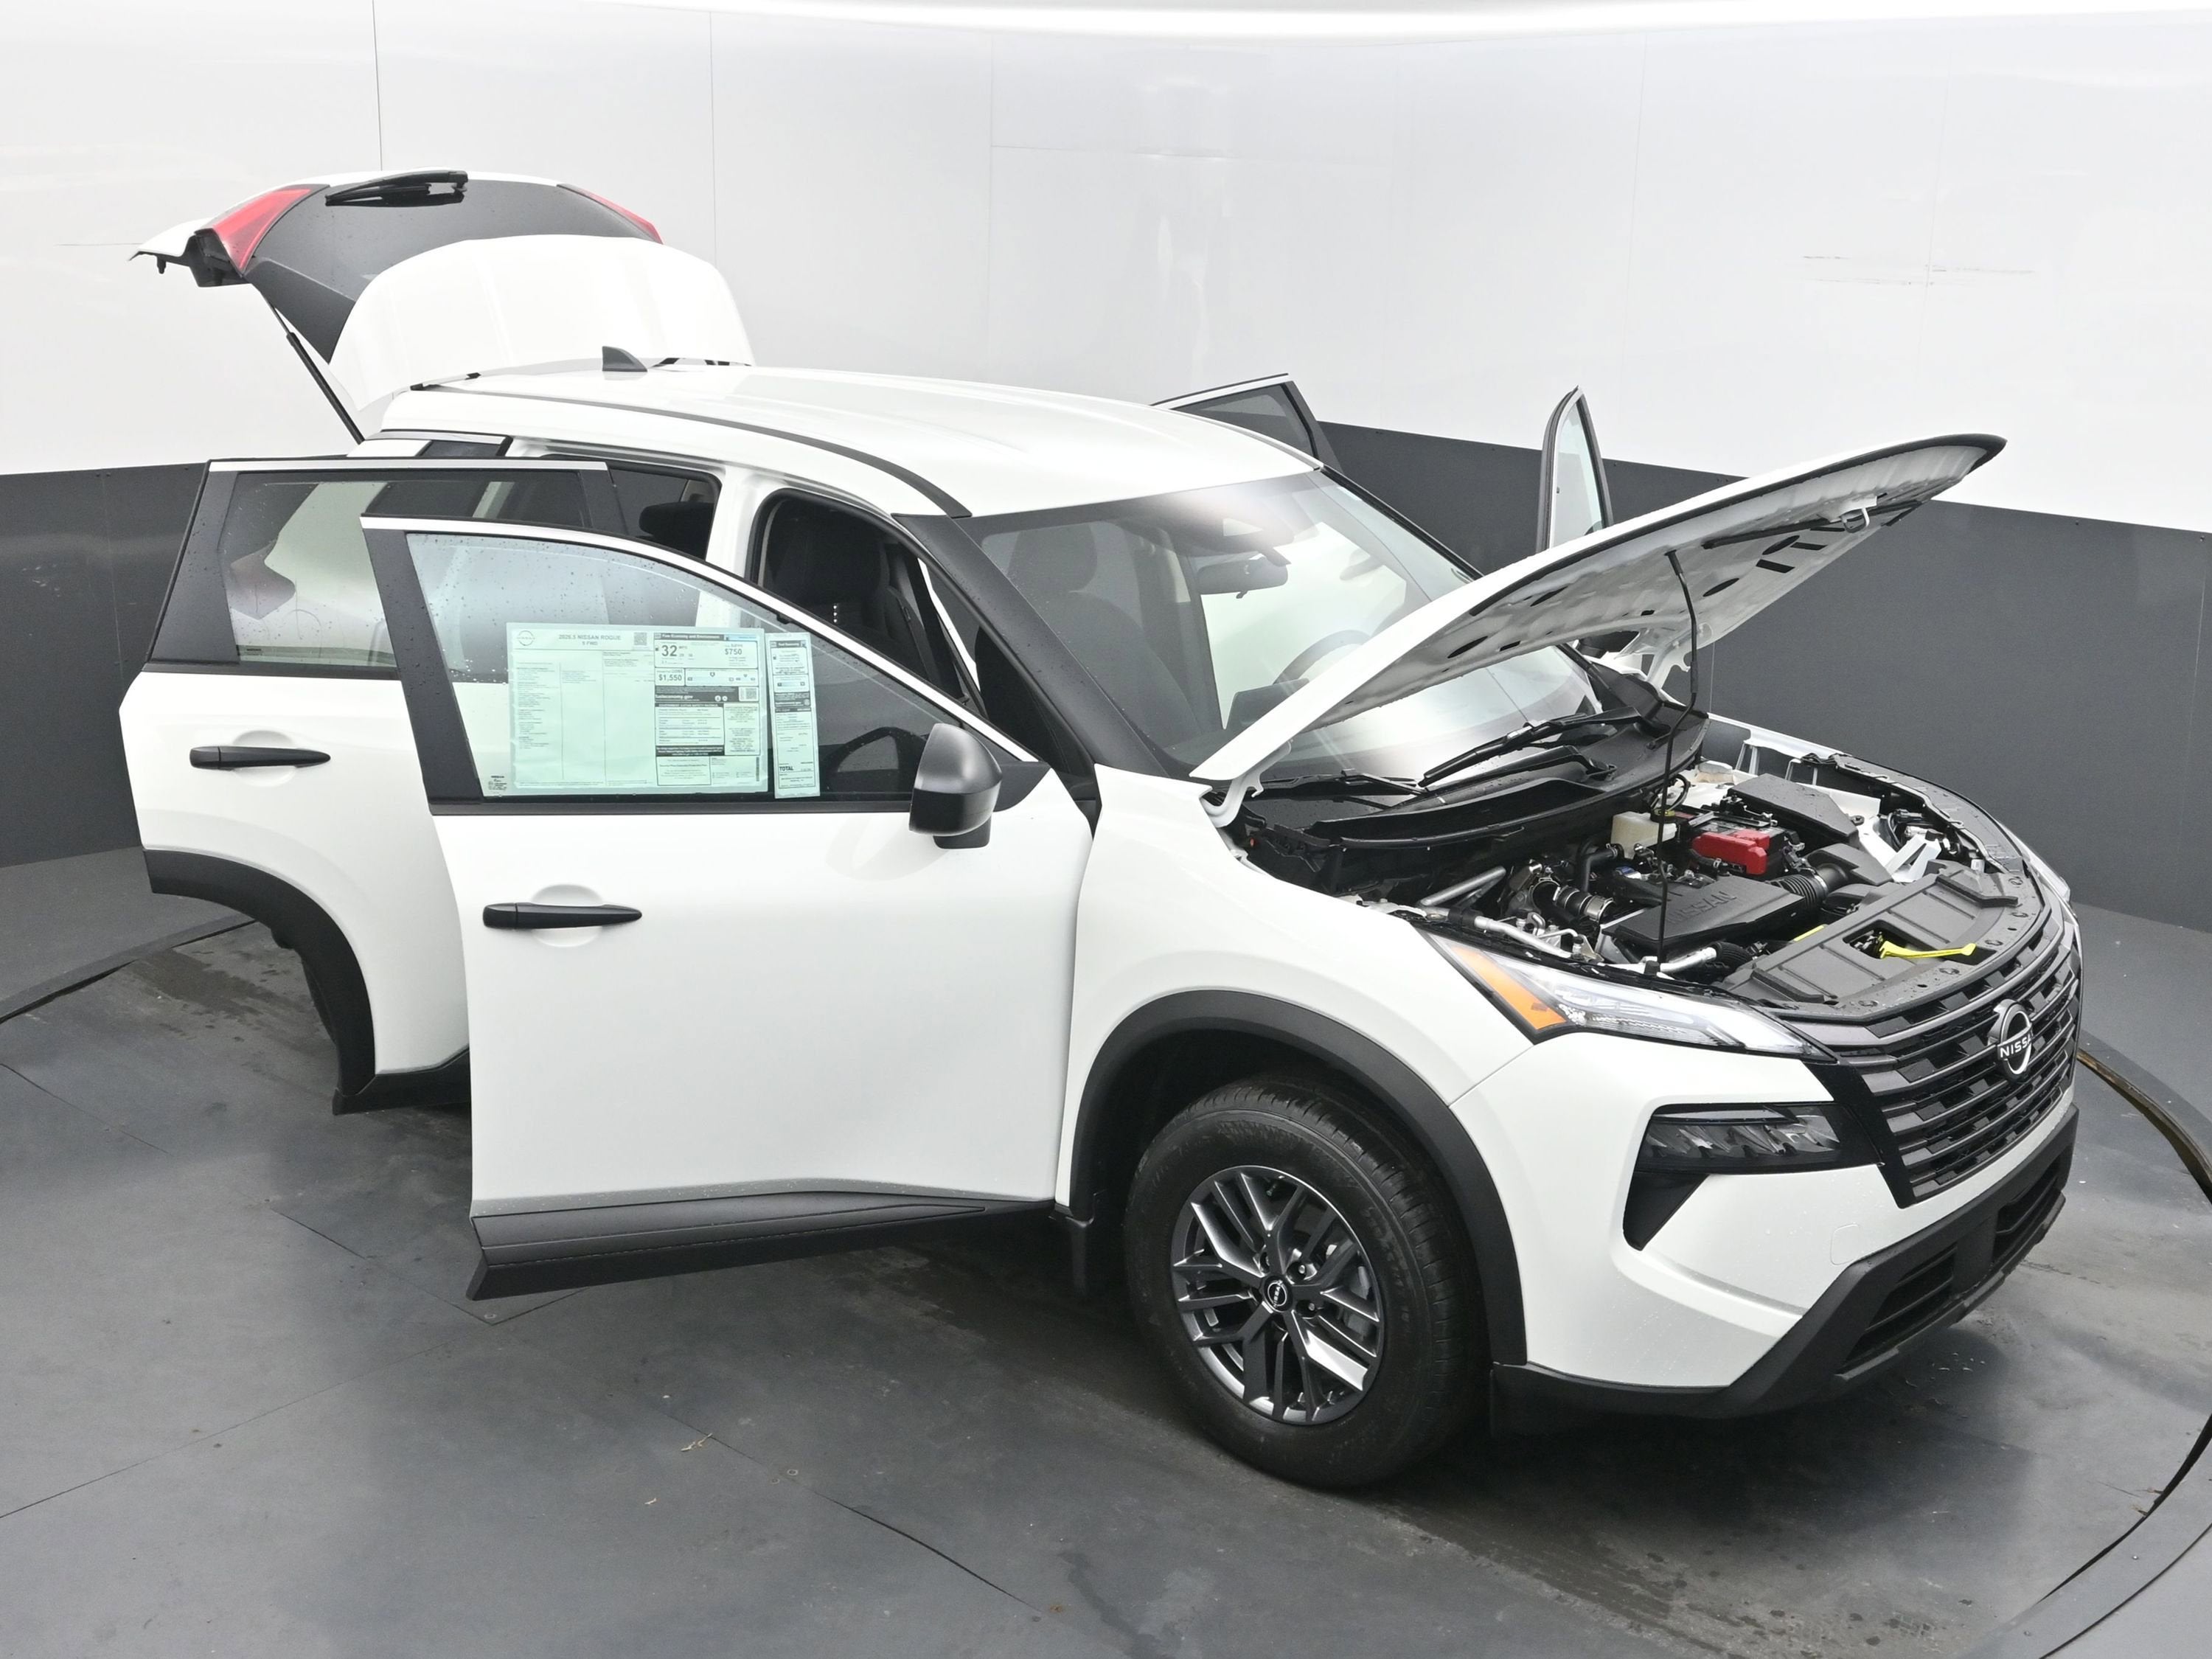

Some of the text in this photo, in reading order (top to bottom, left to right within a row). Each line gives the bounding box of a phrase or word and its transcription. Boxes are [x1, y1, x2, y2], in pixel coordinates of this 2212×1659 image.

[661, 644, 678, 657] 32
[658, 674, 682, 682] $1,550
[2000, 1033, 2032, 1058] NISSA
